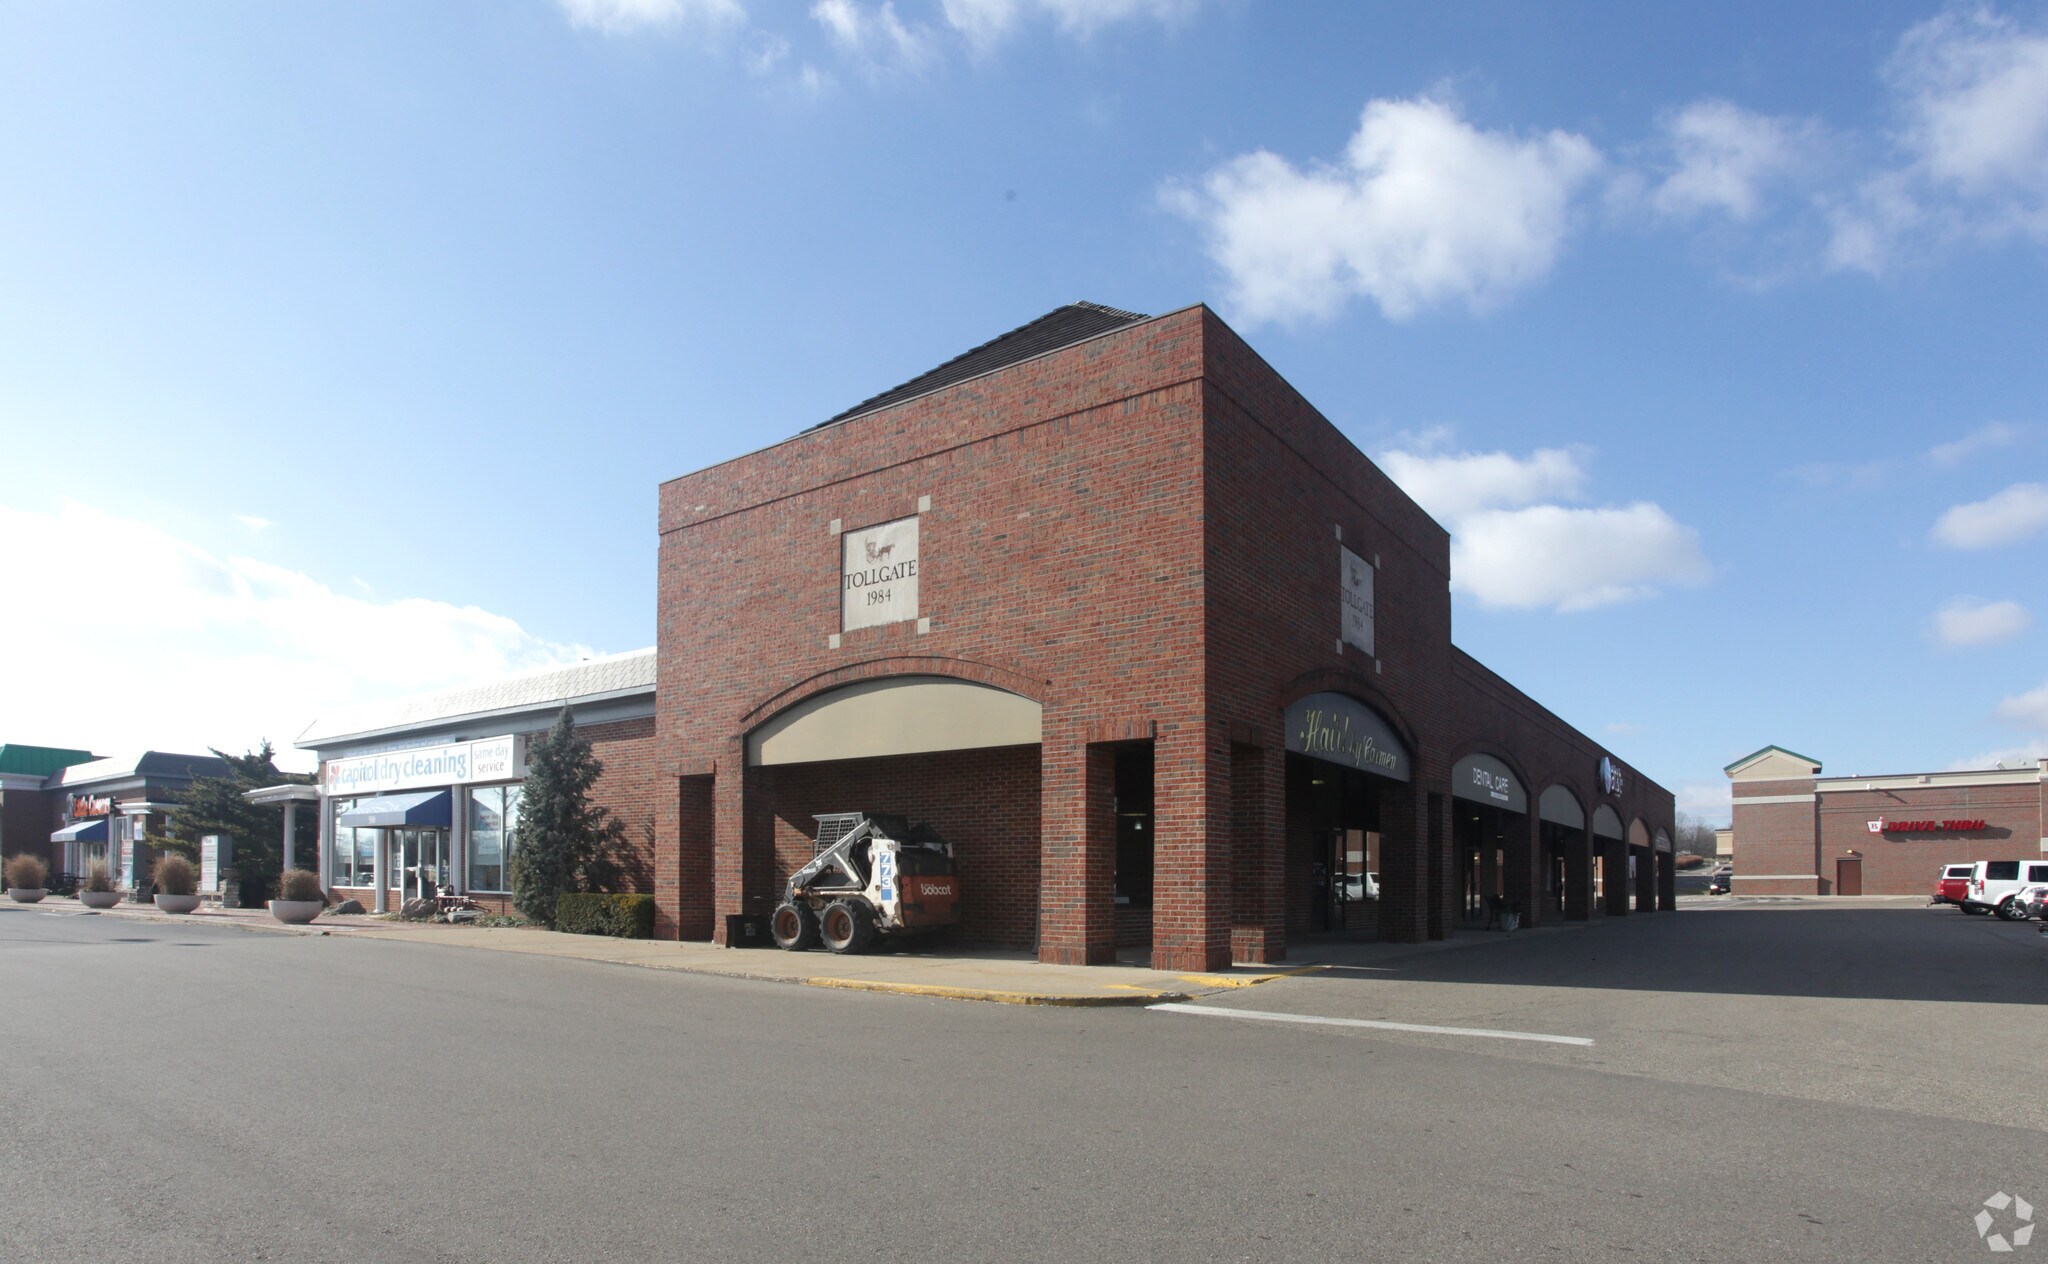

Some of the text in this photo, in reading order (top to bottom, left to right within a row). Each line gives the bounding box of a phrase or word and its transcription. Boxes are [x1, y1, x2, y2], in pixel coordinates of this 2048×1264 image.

[844, 559, 917, 590] TOLLGATE
[867, 588, 891, 606] 1984
[474, 744, 509, 761] same day
[341, 749, 467, 788] capitol dry cleaning
[477, 760, 505, 774] service
[1472, 767, 1509, 794] DENTAL CARE
[880, 852, 892, 888] 773
[920, 883, 952, 896] bobcat
